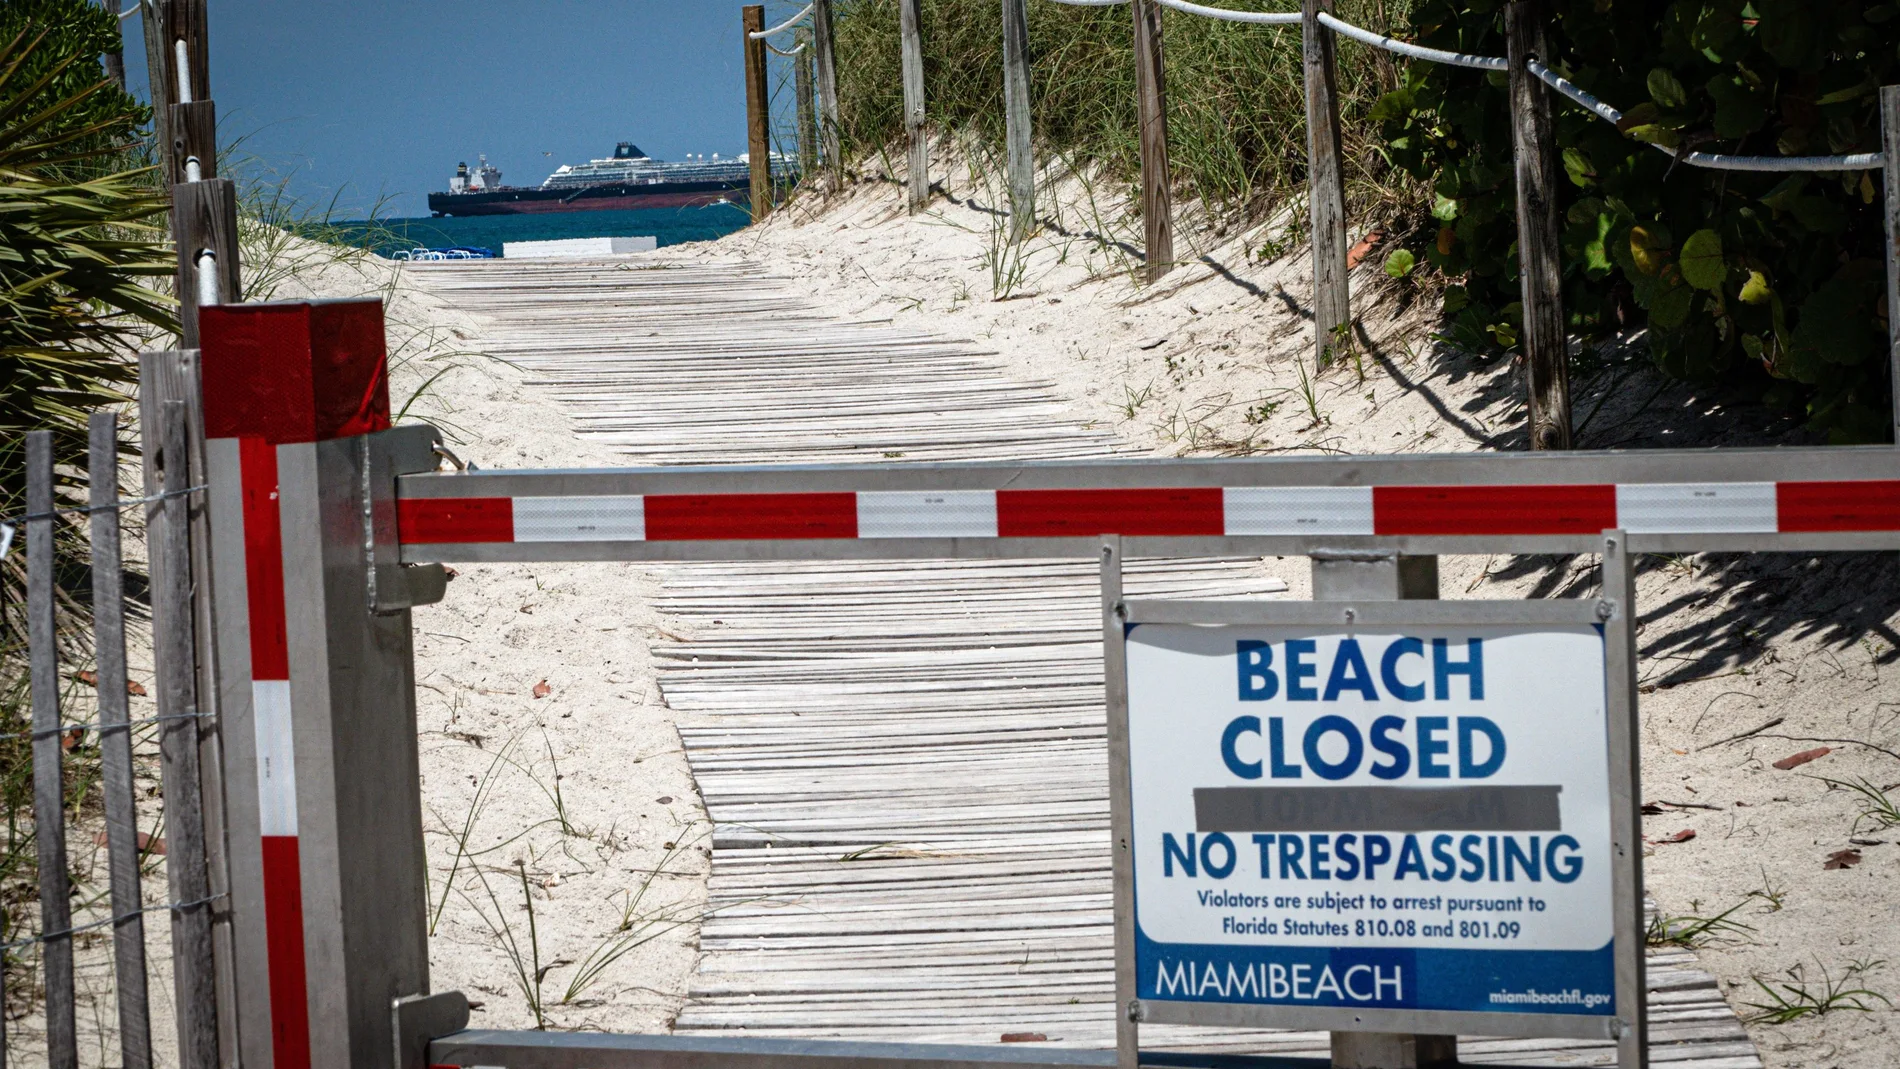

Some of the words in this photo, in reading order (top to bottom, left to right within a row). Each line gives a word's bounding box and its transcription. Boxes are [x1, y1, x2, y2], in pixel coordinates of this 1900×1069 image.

[1236, 637, 1485, 701] BEACH
[1220, 714, 1507, 780] CLOSED
[1162, 832, 1237, 880] NO
[1252, 832, 1584, 884] TRESPASSING
[1197, 889, 1269, 908] Violators
[1274, 896, 1301, 909] are
[1307, 891, 1365, 914] subject
[1370, 895, 1387, 910] to
[1392, 895, 1442, 910] arrest
[1448, 896, 1523, 915] pursuant
[1528, 897, 1546, 912] to
[1223, 916, 1278, 935] Florida
[1284, 917, 1349, 936] Statutes
[1355, 919, 1416, 937] 810.08
[1422, 920, 1454, 937] and
[1459, 921, 1521, 939] 801.09
[1155, 961, 1403, 1001] MIAMIBEACH
[1489, 988, 1611, 1008] miamibeachfl.gov
